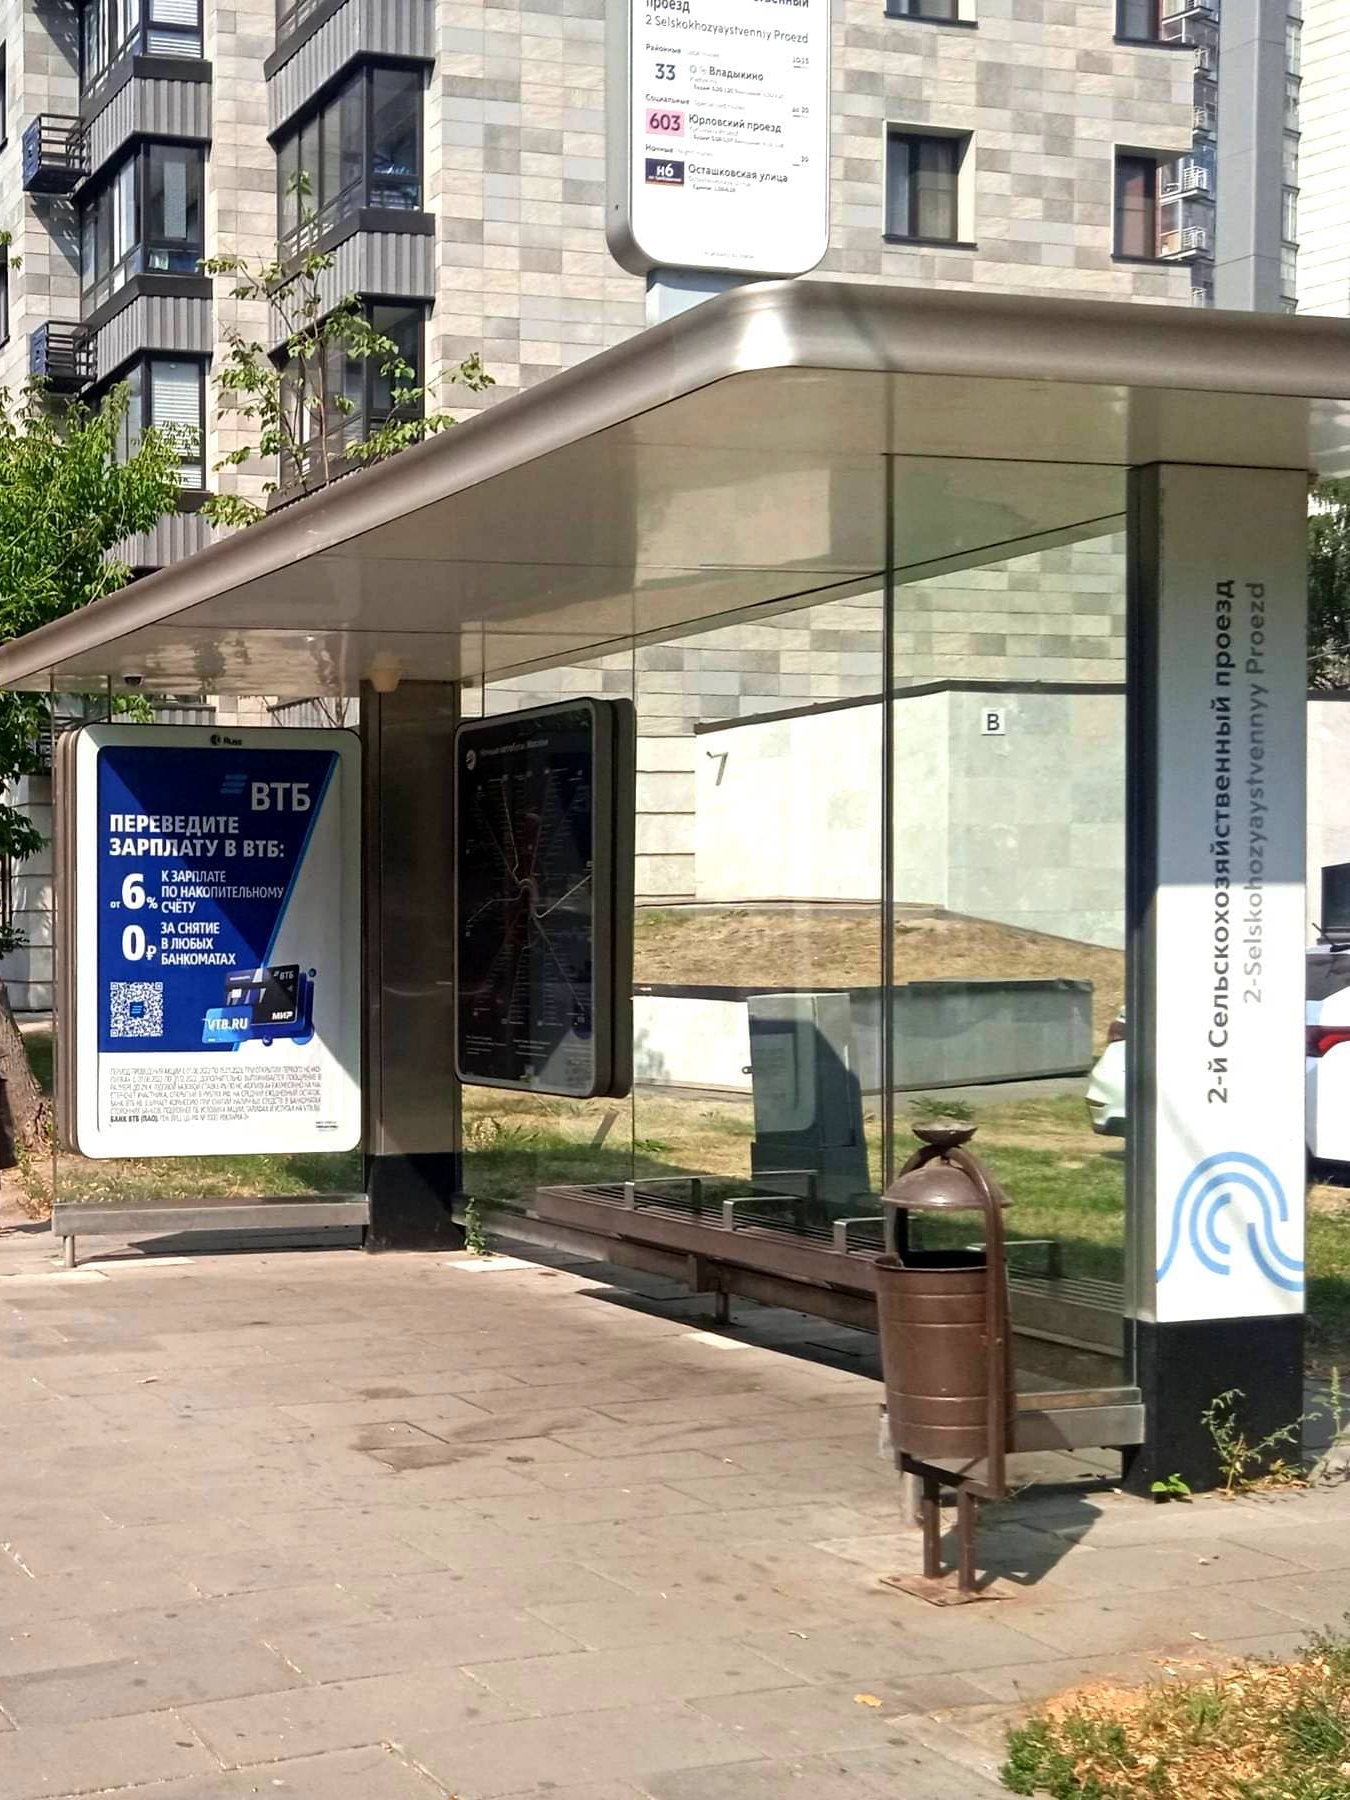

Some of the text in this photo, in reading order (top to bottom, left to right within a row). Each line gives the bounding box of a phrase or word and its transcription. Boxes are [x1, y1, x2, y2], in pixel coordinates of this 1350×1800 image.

[646, 0, 690, 14] проезд
[646, 14, 652, 25] 2
[774, 30, 808, 43] Proezd
[655, 63, 676, 80] 33
[709, 66, 764, 81] Владыкино
[650, 112, 681, 131] 603
[689, 113, 744, 129] Юрловский
[747, 122, 782, 134] проезд
[688, 164, 757, 180] Осташковская
[759, 172, 788, 183] улица
[251, 781, 311, 812] ВТБ
[1243, 582, 1269, 1005] 2-Selskohozyaystvennyy Proezd
[109, 814, 239, 836] ПЕРЕВЕДИТЕ
[109, 838, 285, 857] ЗАРПЛАТУ В ВТБ:
[1206, 580, 1235, 1105] 2-й Сельскохозяйственный проезд
[161, 870, 227, 883] К ЗАРПЛАТЕ
[161, 886, 285, 899] ПО НАКОПИТЕЛЬНОМУ
[110, 900, 121, 909] от
[161, 899, 196, 914] СЧЁТУ
[161, 922, 220, 935] ЗА СНЯТИЕ
[161, 938, 214, 950] В ЛЮБЫХ
[161, 953, 237, 966] БАНКОМАТАХ
[272, 1010, 293, 1021] МИР
[207, 1017, 249, 1030] VTB.RU
